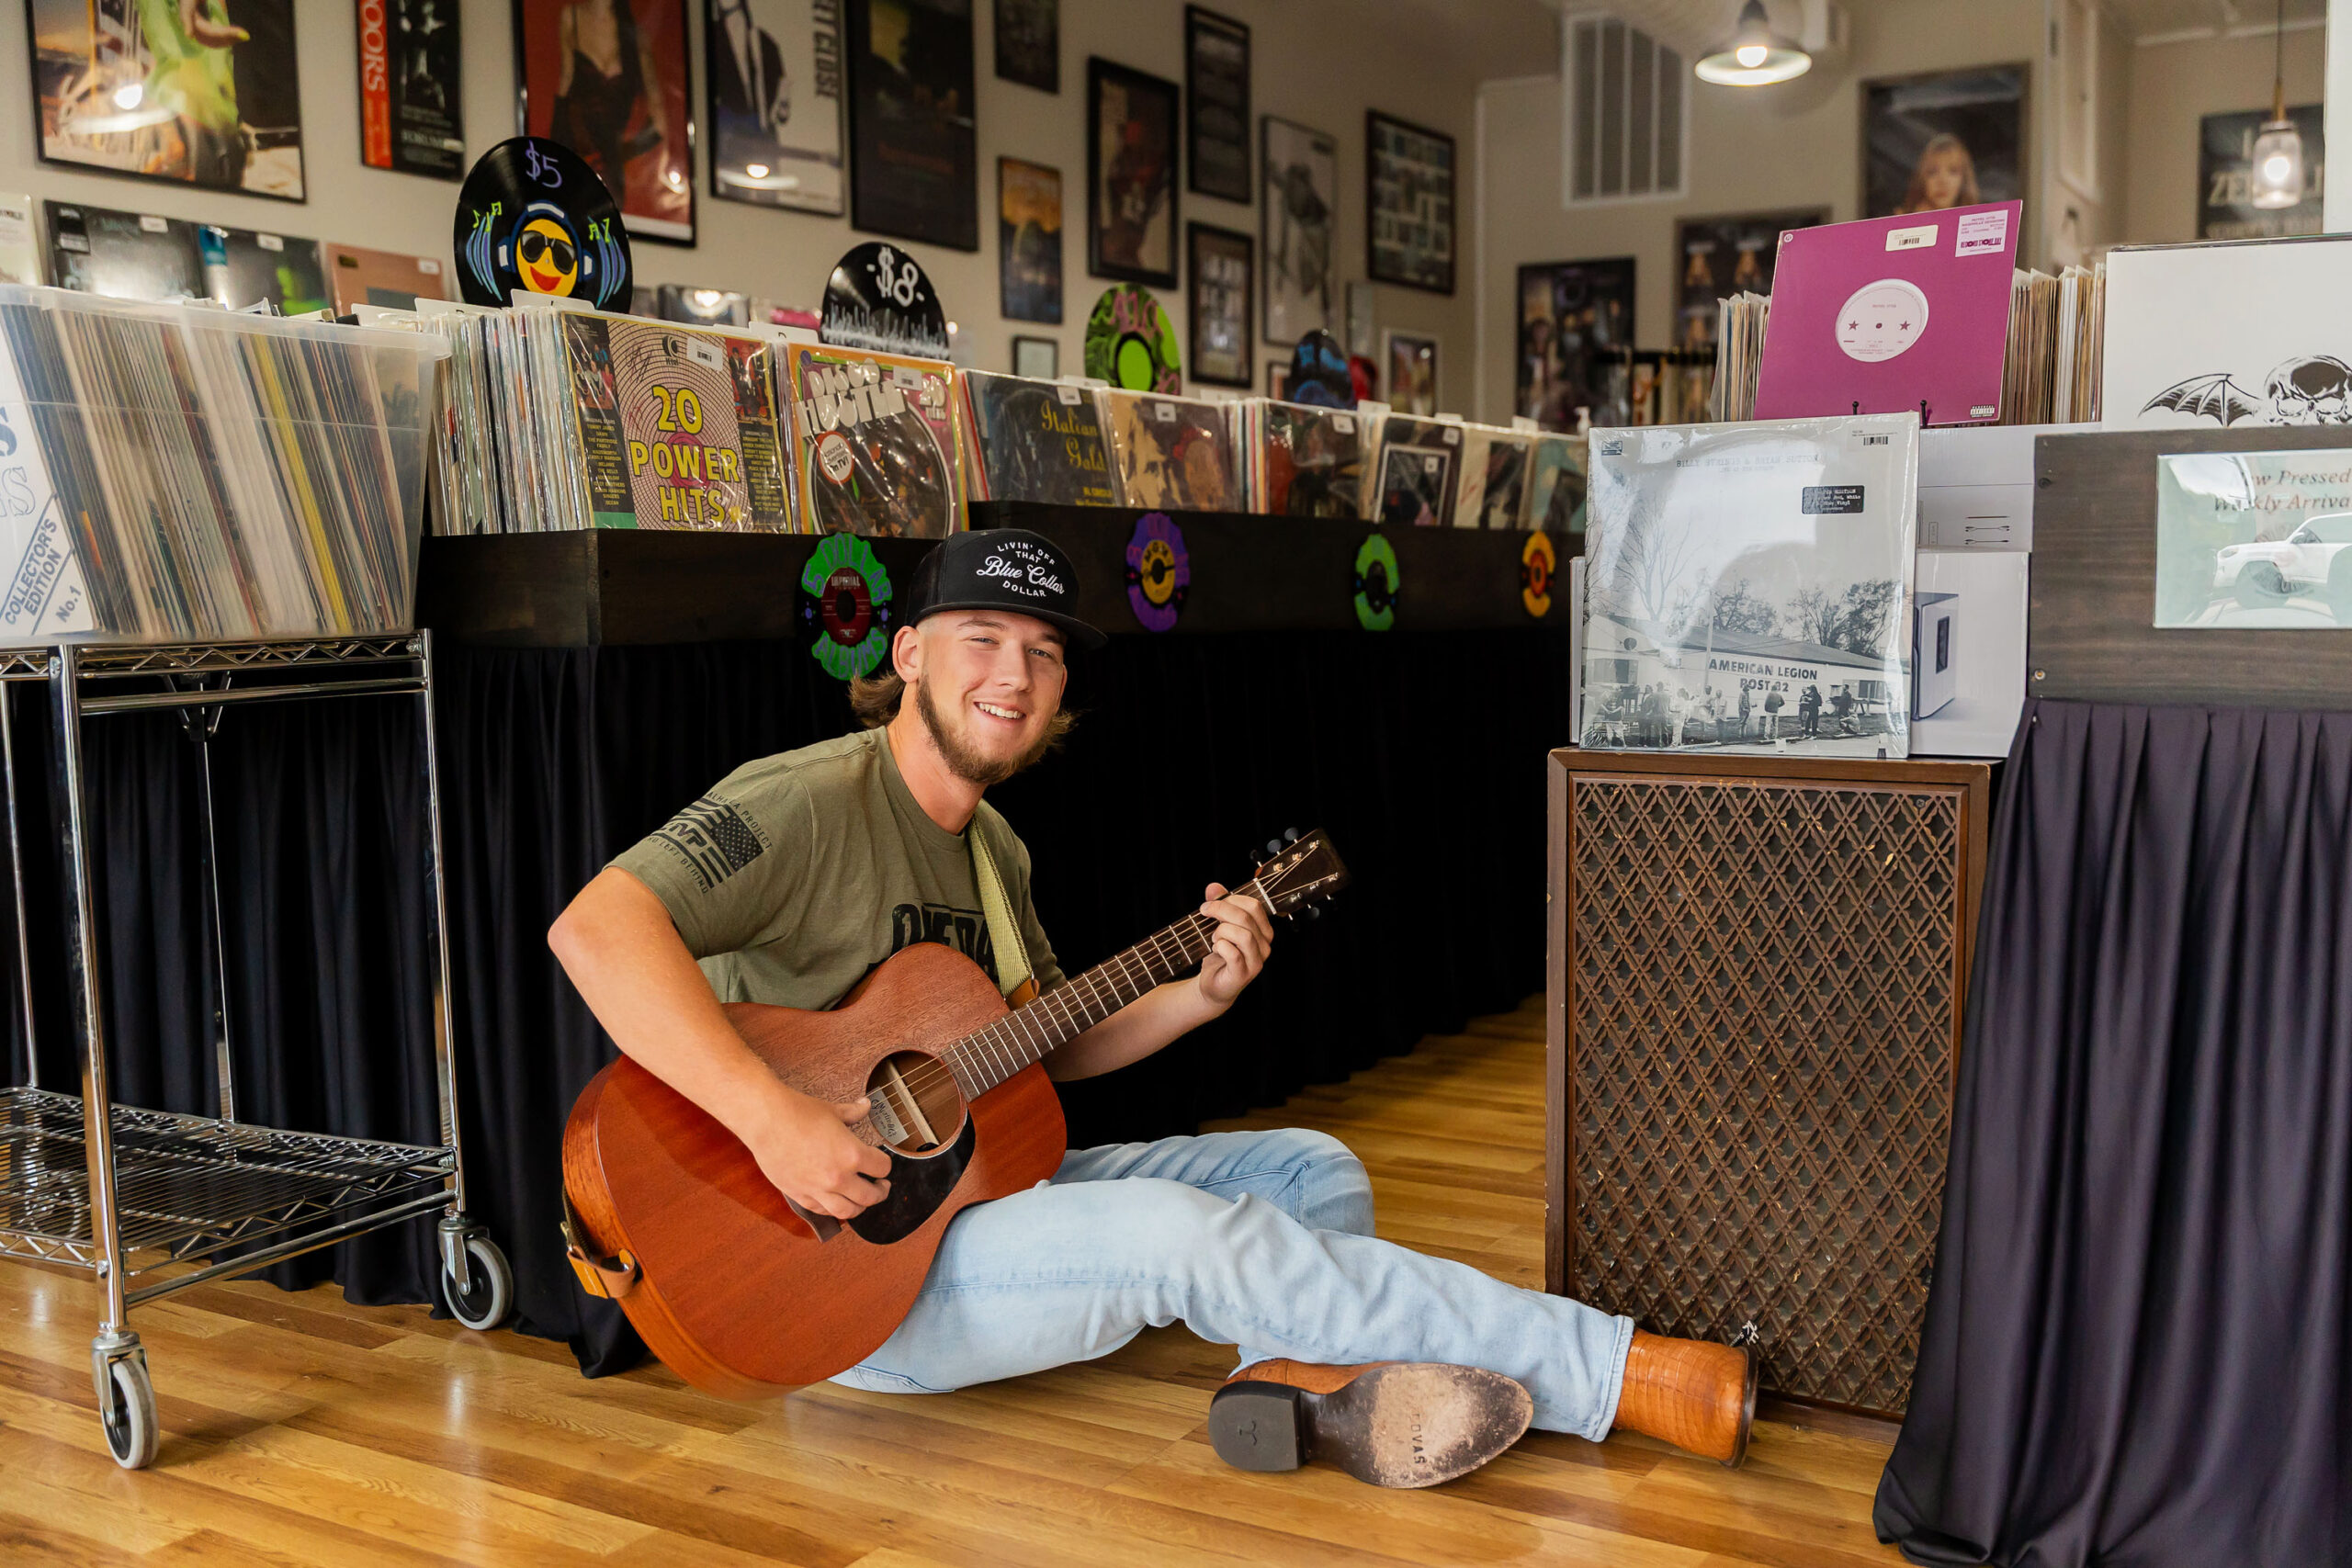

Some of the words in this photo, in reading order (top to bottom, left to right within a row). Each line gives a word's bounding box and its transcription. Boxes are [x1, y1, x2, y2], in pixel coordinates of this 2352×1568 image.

[361, 0, 386, 91] OORS
[525, 140, 562, 188] $5
[876, 246, 919, 308] $8
[651, 385, 704, 434] 20
[1041, 399, 1098, 436] Italian
[628, 439, 741, 483] POWER
[1067, 436, 1107, 472] Gold
[2278, 468, 2352, 486] Pressed
[658, 486, 726, 524] HITS
[2286, 493, 2350, 510] Arriva
[997, 541, 1034, 552] LIVIN'
[1015, 550, 1041, 564] THAT
[5, 518, 57, 626] COLLECTOR'S
[24, 548, 62, 617] EDITION
[820, 534, 893, 604] DOLLAR
[976, 555, 1023, 579] Blue
[1026, 563, 1065, 594] Collar
[1002, 580, 1047, 598] DOLLAR
[814, 629, 886, 679] ALBUMS
[1709, 659, 1772, 676] AMERICAN
[1778, 666, 1818, 681] LEGION
[1739, 678, 1770, 691] POST
[741, 809, 773, 850] PROJECT
[659, 842, 680, 858] LEFT
[680, 858, 709, 895] BEHIND
